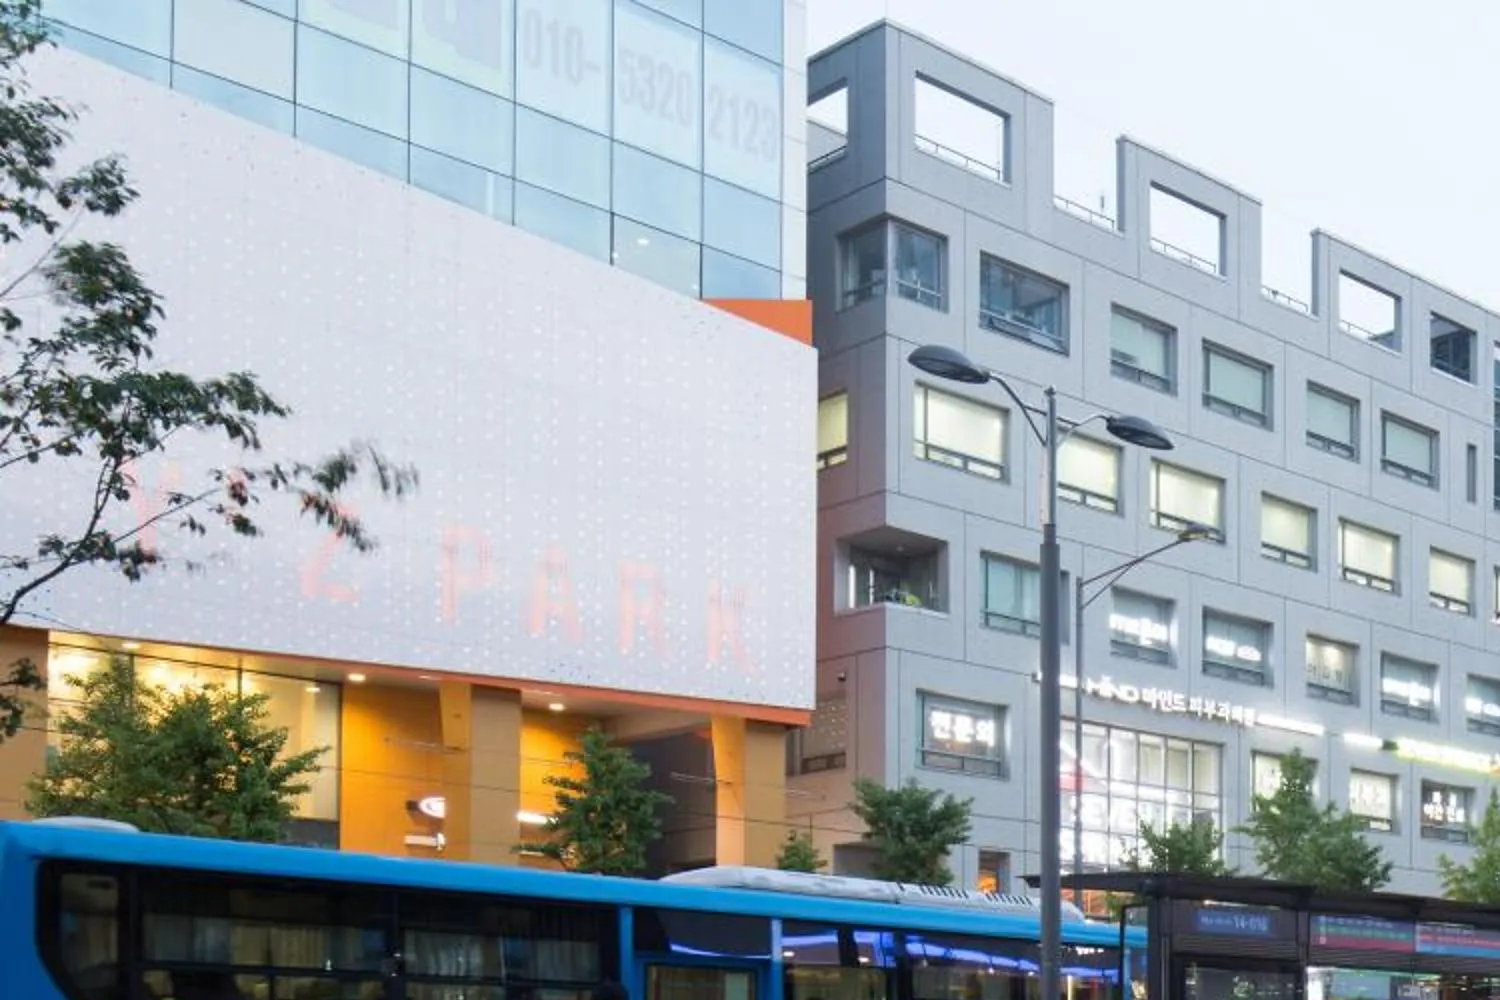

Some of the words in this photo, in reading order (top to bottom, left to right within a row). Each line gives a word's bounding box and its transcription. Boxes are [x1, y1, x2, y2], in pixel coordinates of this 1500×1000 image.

[523, 7, 601, 87] 010-
[618, 46, 693, 129] 5320
[709, 84, 778, 163] 2123
[435, 522, 760, 677] PARK
